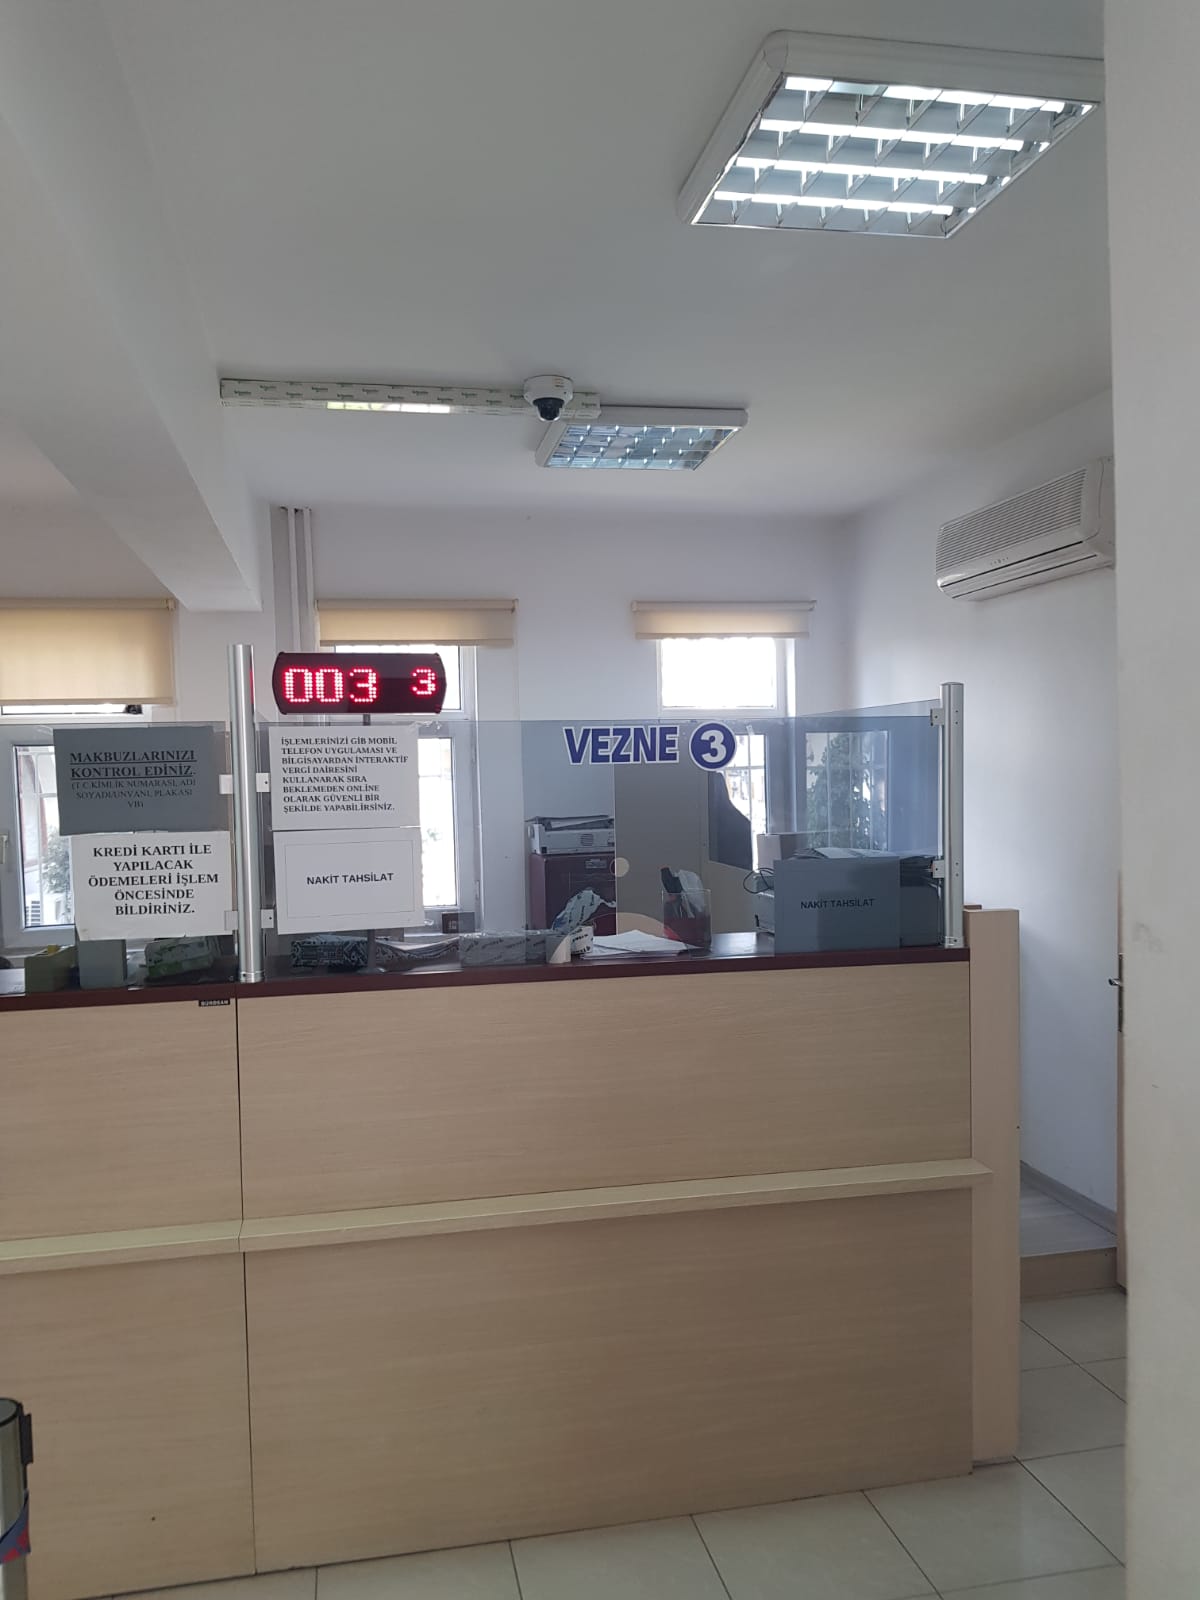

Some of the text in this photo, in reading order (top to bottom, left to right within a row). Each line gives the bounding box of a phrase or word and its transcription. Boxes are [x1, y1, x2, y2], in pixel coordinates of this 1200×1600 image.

[285, 668, 436, 703] 003 3
[281, 736, 397, 746] İŞLEMLERİNİZİ GİB MOBİL
[562, 725, 727, 765] VEZNE 3
[70, 750, 195, 763] MAKBUZLARINIZI
[281, 747, 323, 755] TELEFON
[386, 746, 397, 754] VE
[281, 755, 409, 765] BİLGİSAYARDAN İNTERAKTİF
[71, 763, 196, 778] KONTROL EDİNİZ.
[282, 764, 358, 774] VERGİ DAİRESİNİ
[282, 775, 367, 784] KULLANARAK SIRA
[283, 783, 380, 793] BEKLEMEDEN ONLİNE
[283, 793, 380, 803] OLARAK GÜVENLİ BİR
[283, 804, 322, 813] ŞEKİLDE
[93, 842, 212, 857] KREDİ KARTI İLE
[113, 859, 194, 872] YAPILACAK
[88, 872, 218, 887] ÖDEMELERİ İŞLEM
[306, 871, 394, 885] NAKİT TAHSİLAT
[114, 887, 194, 901] ÖNCESİNDE
[115, 901, 195, 915] BİLDİRİNİZ.
[800, 897, 876, 909] NAKİT TAHSİLAT
